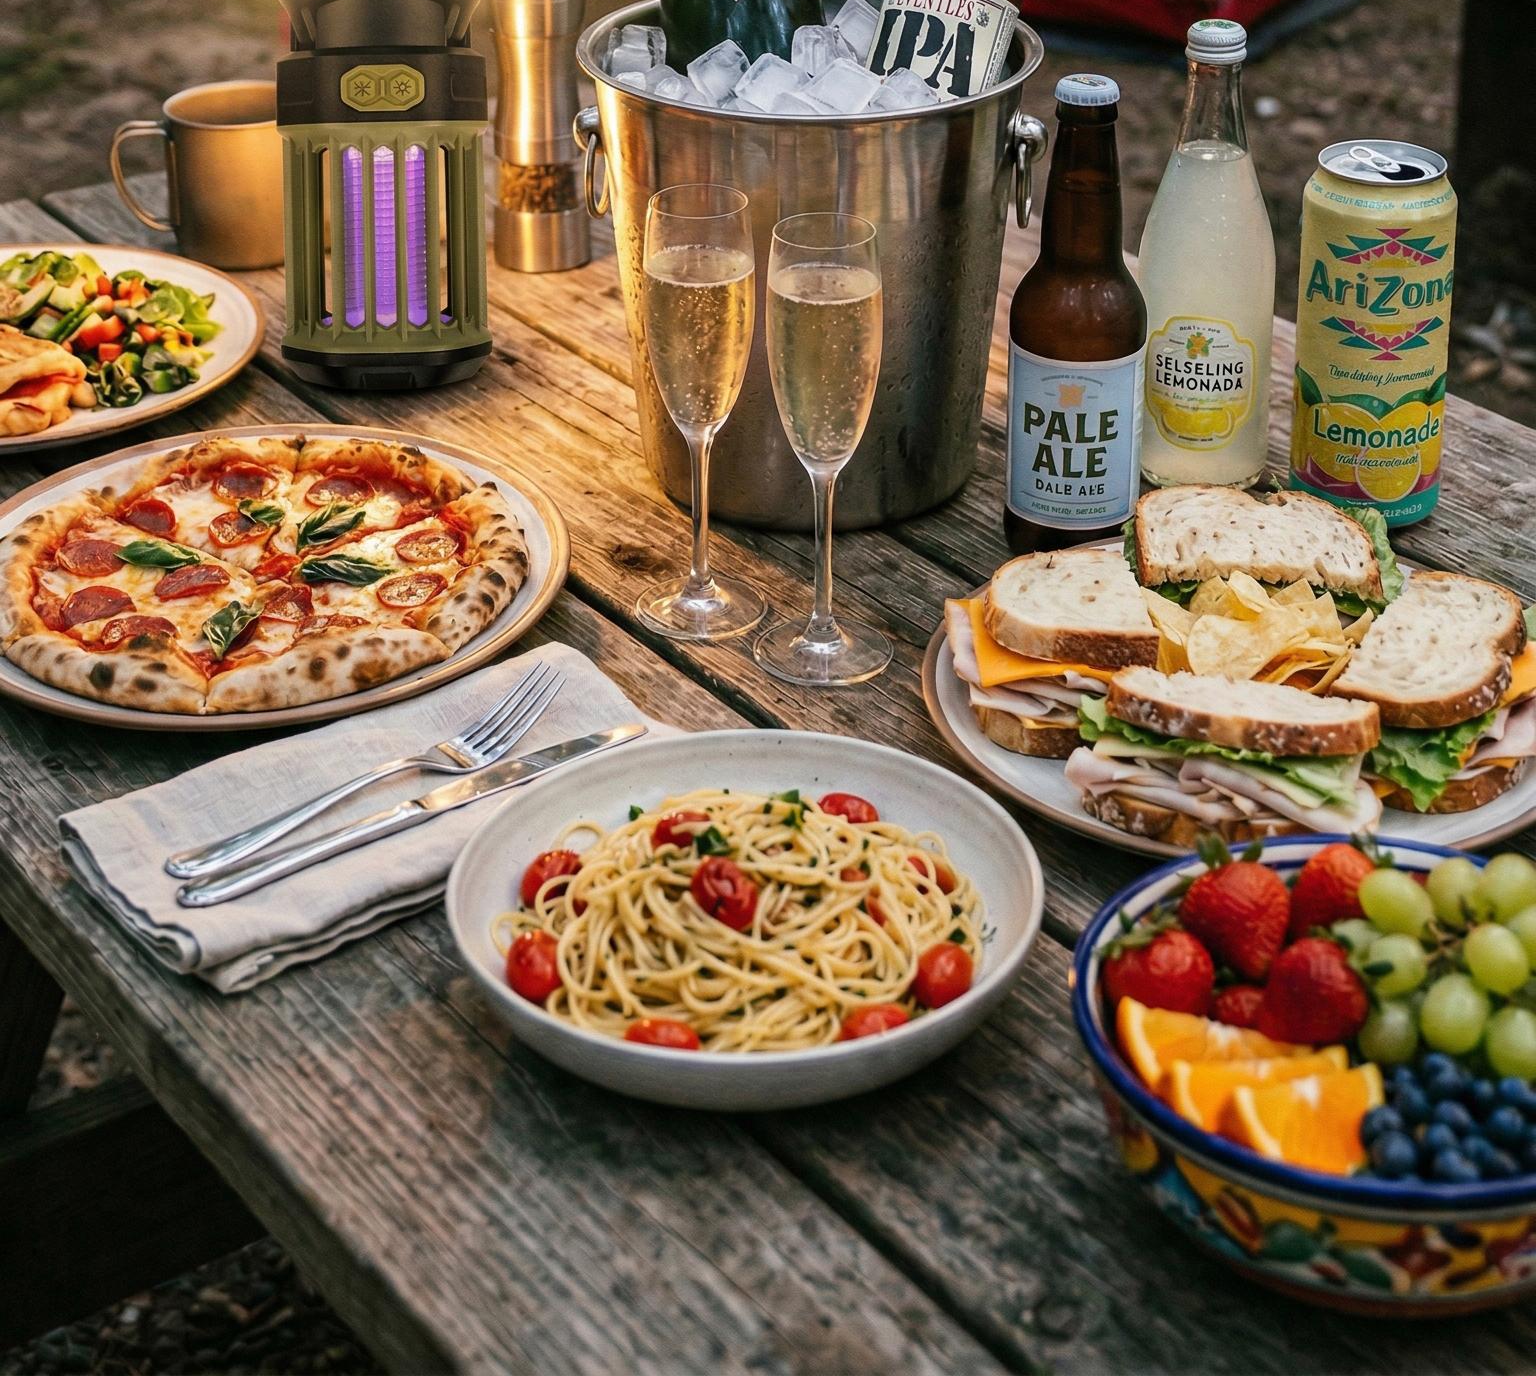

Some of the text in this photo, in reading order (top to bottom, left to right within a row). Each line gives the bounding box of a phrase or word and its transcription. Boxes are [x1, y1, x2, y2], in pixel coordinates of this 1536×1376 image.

[869, 8, 976, 98] IPA
[1155, 353, 1244, 376] SELSELING
[1155, 368, 1243, 392] LEMONADA
[1023, 402, 1119, 444] PALE
[1313, 408, 1440, 449] Lemonade
[1031, 442, 1108, 479] ALE
